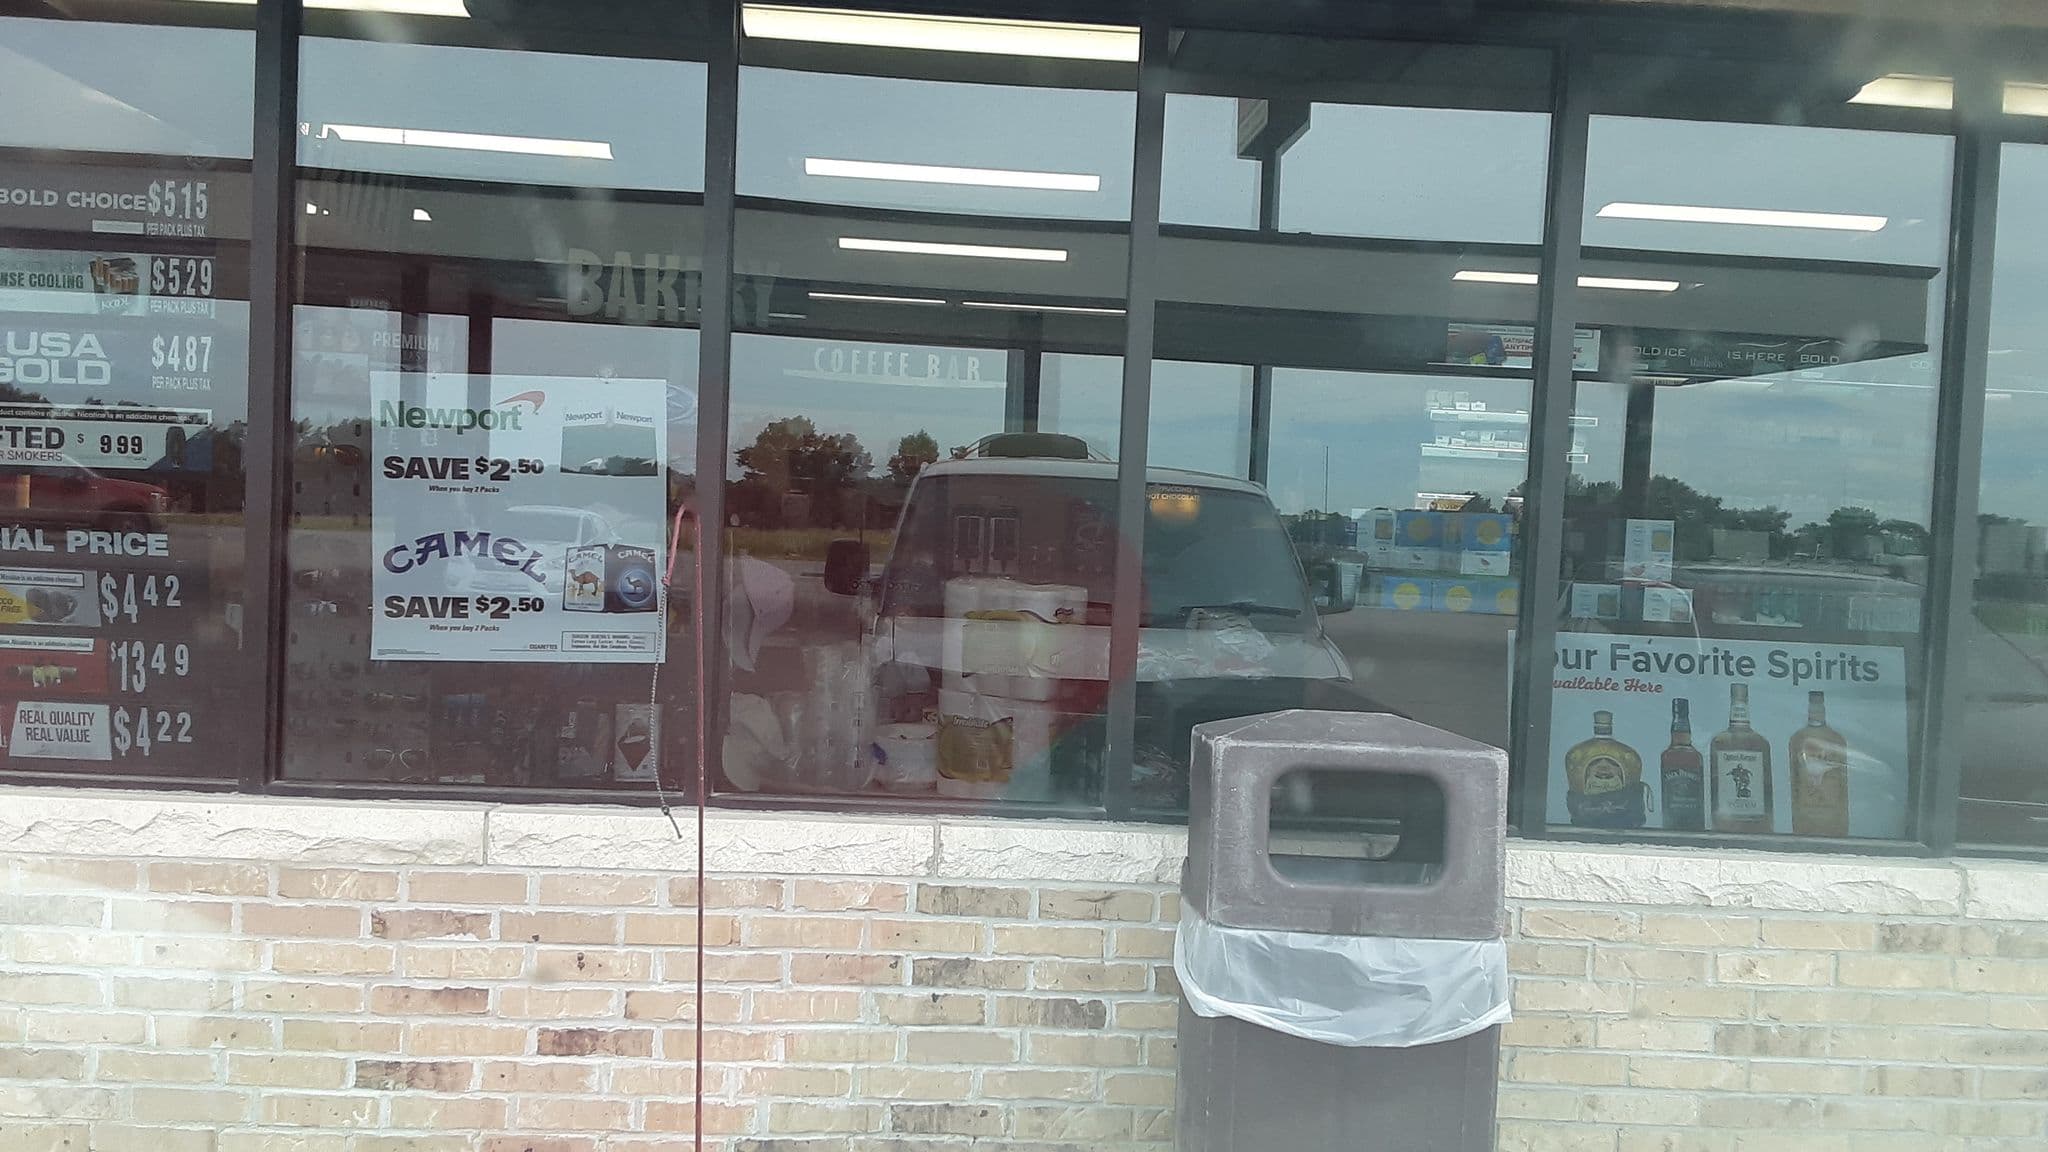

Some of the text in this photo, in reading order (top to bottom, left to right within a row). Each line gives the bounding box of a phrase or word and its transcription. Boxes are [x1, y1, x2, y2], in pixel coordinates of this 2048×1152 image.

[66, 190, 147, 211] CHOICE
[148, 179, 208, 219] $5.15
[160, 222, 176, 236] PACK
[29, 272, 84, 290] COOLING
[151, 257, 214, 296] $5.29
[6, 331, 108, 359] USA
[372, 331, 439, 353] PREMIUM
[151, 333, 212, 373] $4.87
[1632, 346, 1840, 365] OLD ICE IS HERE BOLD
[813, 346, 981, 383] COFFEE BAR
[165, 376, 181, 390] PACK
[379, 400, 522, 435] Newport
[565, 411, 603, 422] Newport
[616, 411, 653, 423] Newport
[0, 425, 65, 449] TED
[77, 432, 85, 444] $
[7, 450, 63, 461] SMOKERS
[383, 454, 545, 482] SAVE $2.50
[449, 486, 461, 494] you
[462, 485, 474, 494] buy
[66, 530, 169, 557] PRICE
[383, 530, 547, 585] CAMEL
[617, 549, 655, 564] CAMEL
[384, 594, 545, 620] SAVE $2.50
[449, 625, 461, 633] you
[462, 624, 474, 633] buy
[1609, 643, 1756, 677] Favorite
[1767, 649, 1880, 686] Spirits
[1623, 677, 1664, 693] Here
[19, 709, 95, 727] REAL QUALITY
[25, 727, 54, 742] REAL
[55, 728, 91, 743] VALUE
